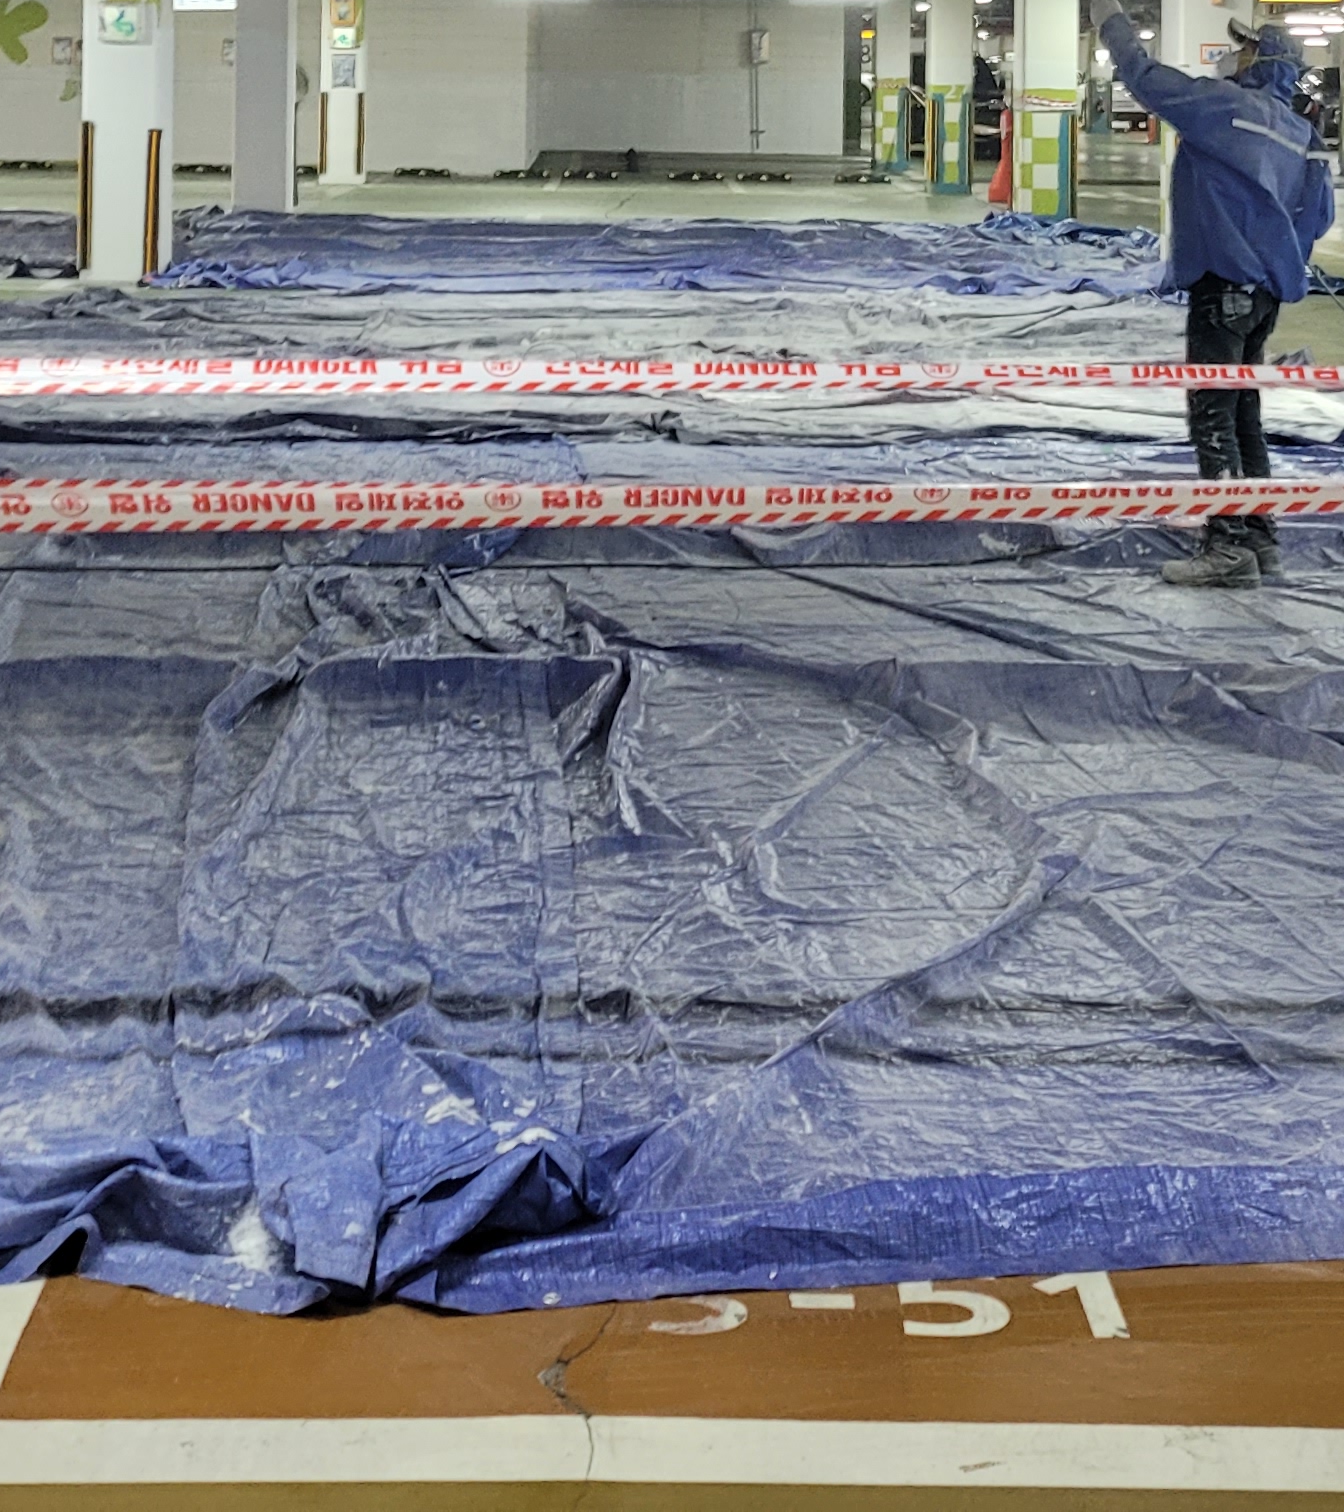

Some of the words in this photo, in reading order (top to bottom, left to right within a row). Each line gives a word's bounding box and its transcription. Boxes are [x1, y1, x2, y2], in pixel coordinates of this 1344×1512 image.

[193, 493, 316, 513] DANGER
[335, 491, 464, 512] 안전제일
[624, 487, 746, 508] DANGER
